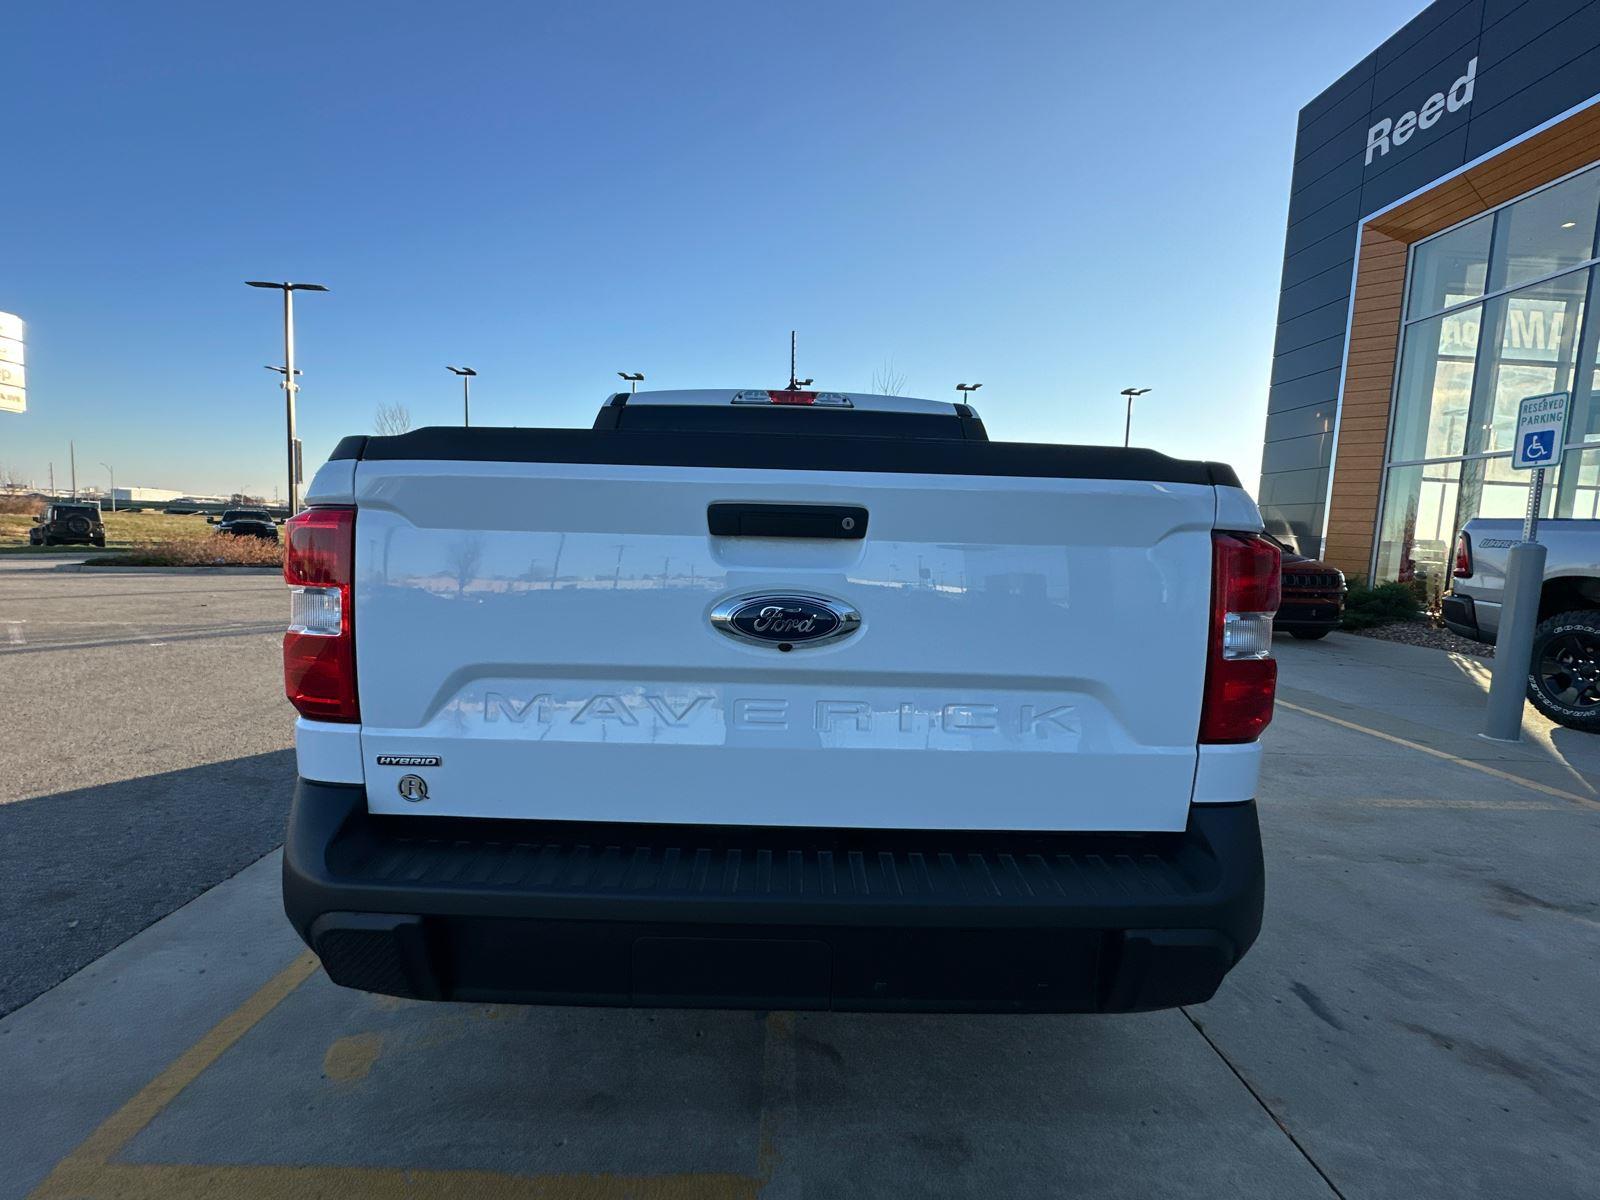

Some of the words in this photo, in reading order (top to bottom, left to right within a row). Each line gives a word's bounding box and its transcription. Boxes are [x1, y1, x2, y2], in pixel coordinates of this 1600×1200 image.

[1364, 56, 1479, 167] Reed
[1523, 398, 1564, 414] RESERVED
[1521, 412, 1563, 426] PARKING
[1479, 538, 1538, 549] WARLO
[753, 606, 817, 633] Ford
[484, 692, 1081, 736] MAVERICK
[380, 757, 437, 765] HYBRID
